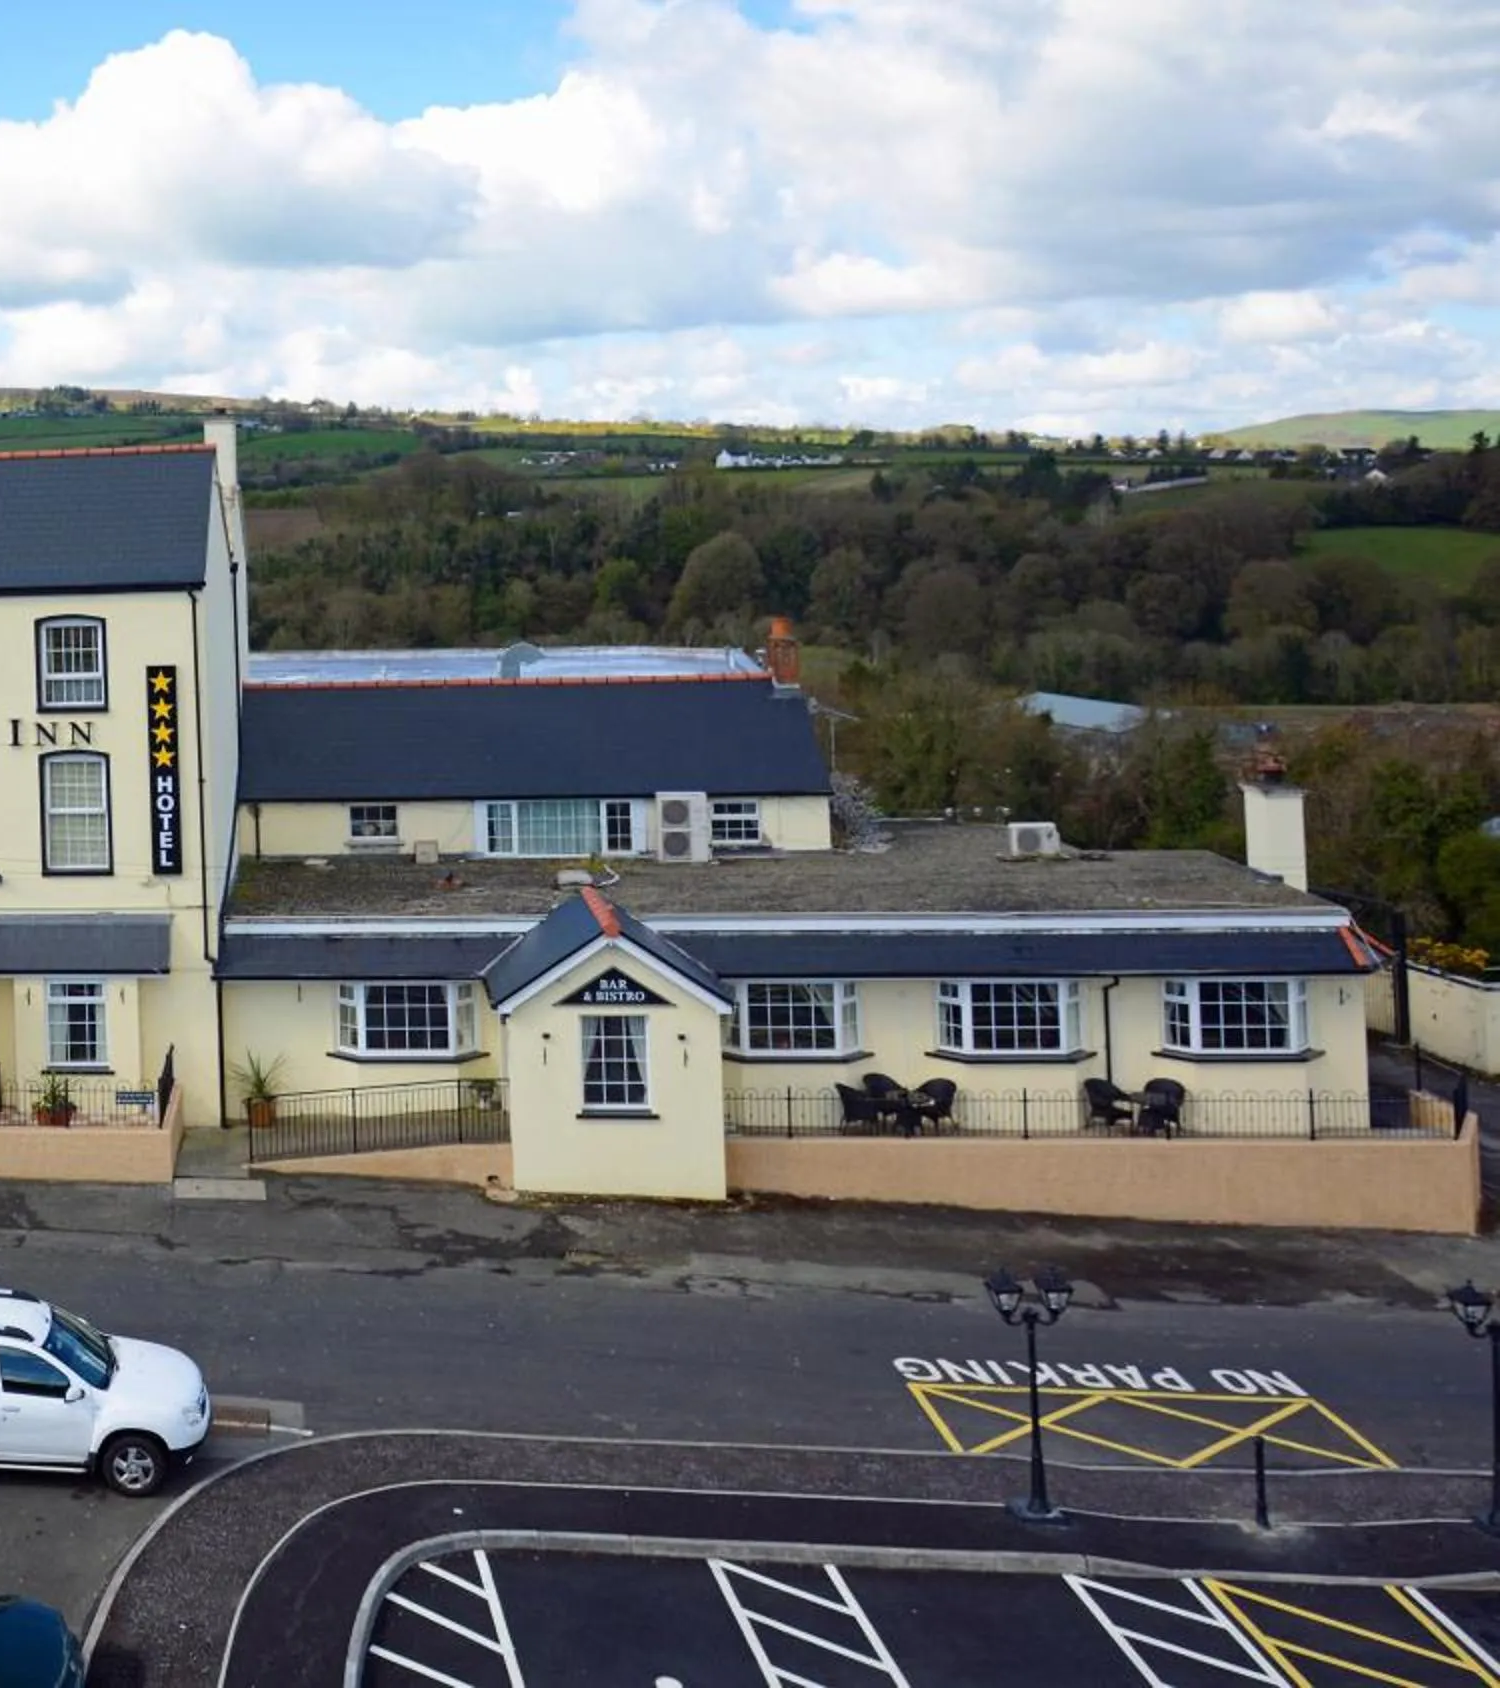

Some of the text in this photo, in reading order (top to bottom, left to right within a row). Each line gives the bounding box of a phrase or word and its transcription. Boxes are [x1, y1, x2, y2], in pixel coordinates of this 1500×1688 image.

[8, 719, 94, 748] INN
[156, 776, 175, 867] HOTEL
[583, 990, 646, 1002] & BISTRO
[599, 979, 628, 991] BAR
[892, 1356, 1310, 1397] NO PARKING
